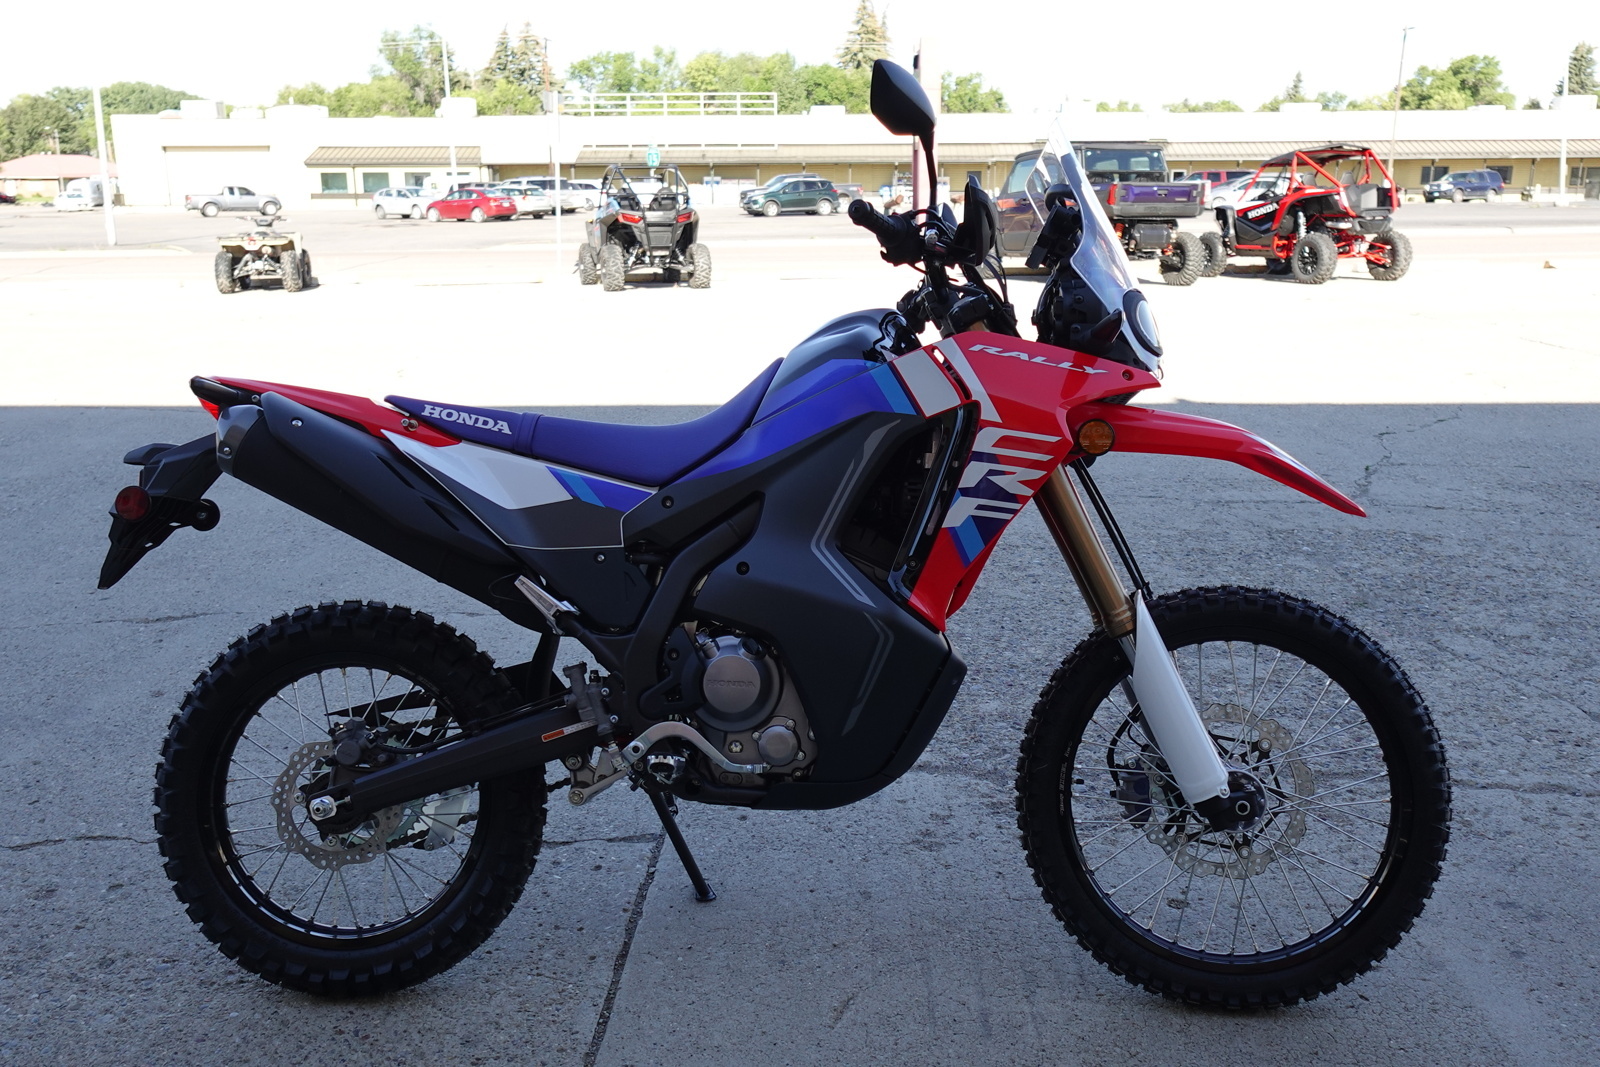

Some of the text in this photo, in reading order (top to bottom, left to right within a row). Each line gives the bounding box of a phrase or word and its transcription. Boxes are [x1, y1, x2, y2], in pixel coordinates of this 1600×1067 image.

[1247, 202, 1279, 219] HONDA
[968, 344, 1108, 374] RALLY
[421, 404, 512, 434] HONDA
[941, 426, 1063, 528] CRF
[706, 680, 756, 689] HONDA
